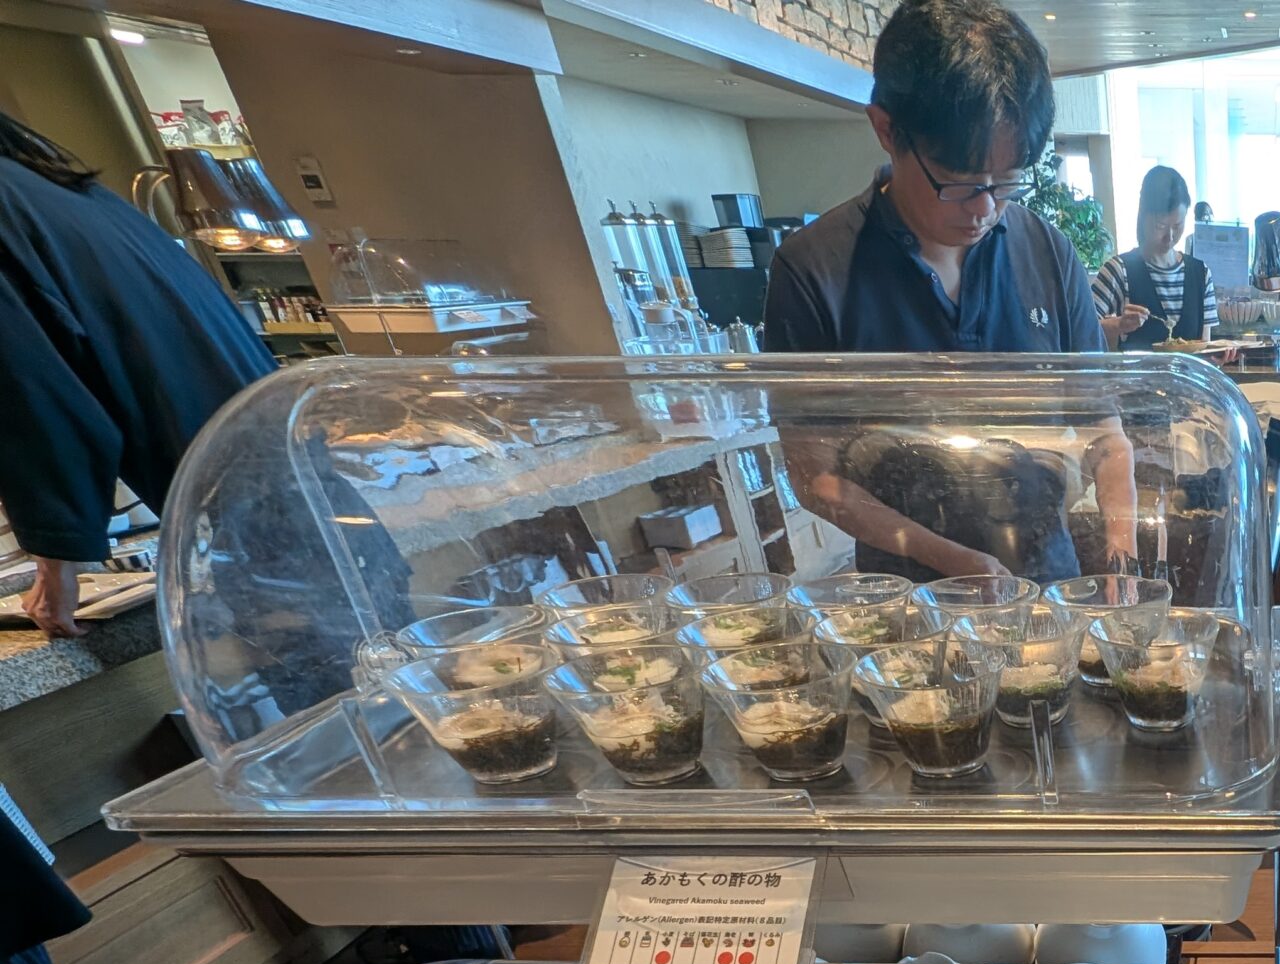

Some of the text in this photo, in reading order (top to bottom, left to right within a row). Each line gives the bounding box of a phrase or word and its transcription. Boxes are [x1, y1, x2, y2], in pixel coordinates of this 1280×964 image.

[640, 872, 782, 888] あかもくの酢の物
[648, 896, 766, 906] Vinegared Akamoku seaweed
